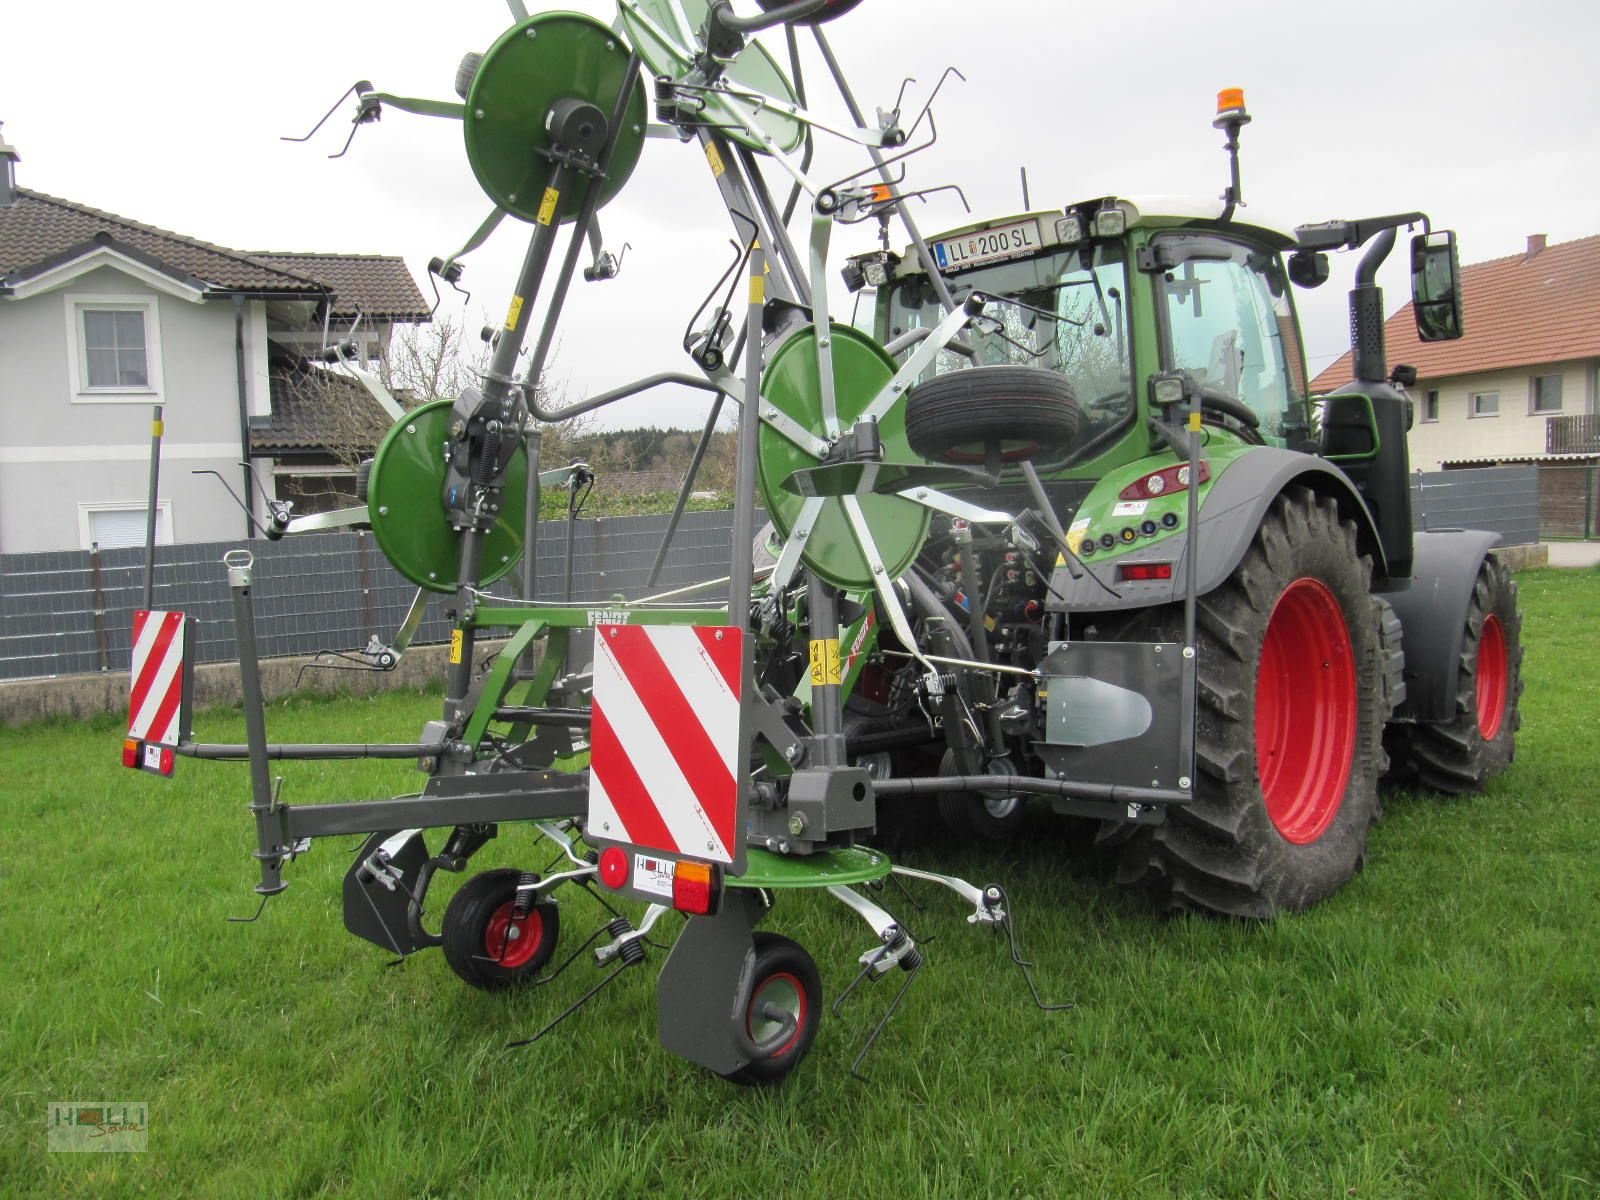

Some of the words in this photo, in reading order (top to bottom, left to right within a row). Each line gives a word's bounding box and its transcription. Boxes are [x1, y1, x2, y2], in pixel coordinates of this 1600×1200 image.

[950, 242, 968, 262] LL
[978, 232, 1009, 255] 200
[1012, 228, 1032, 247] SL
[587, 610, 631, 626] FENDT
